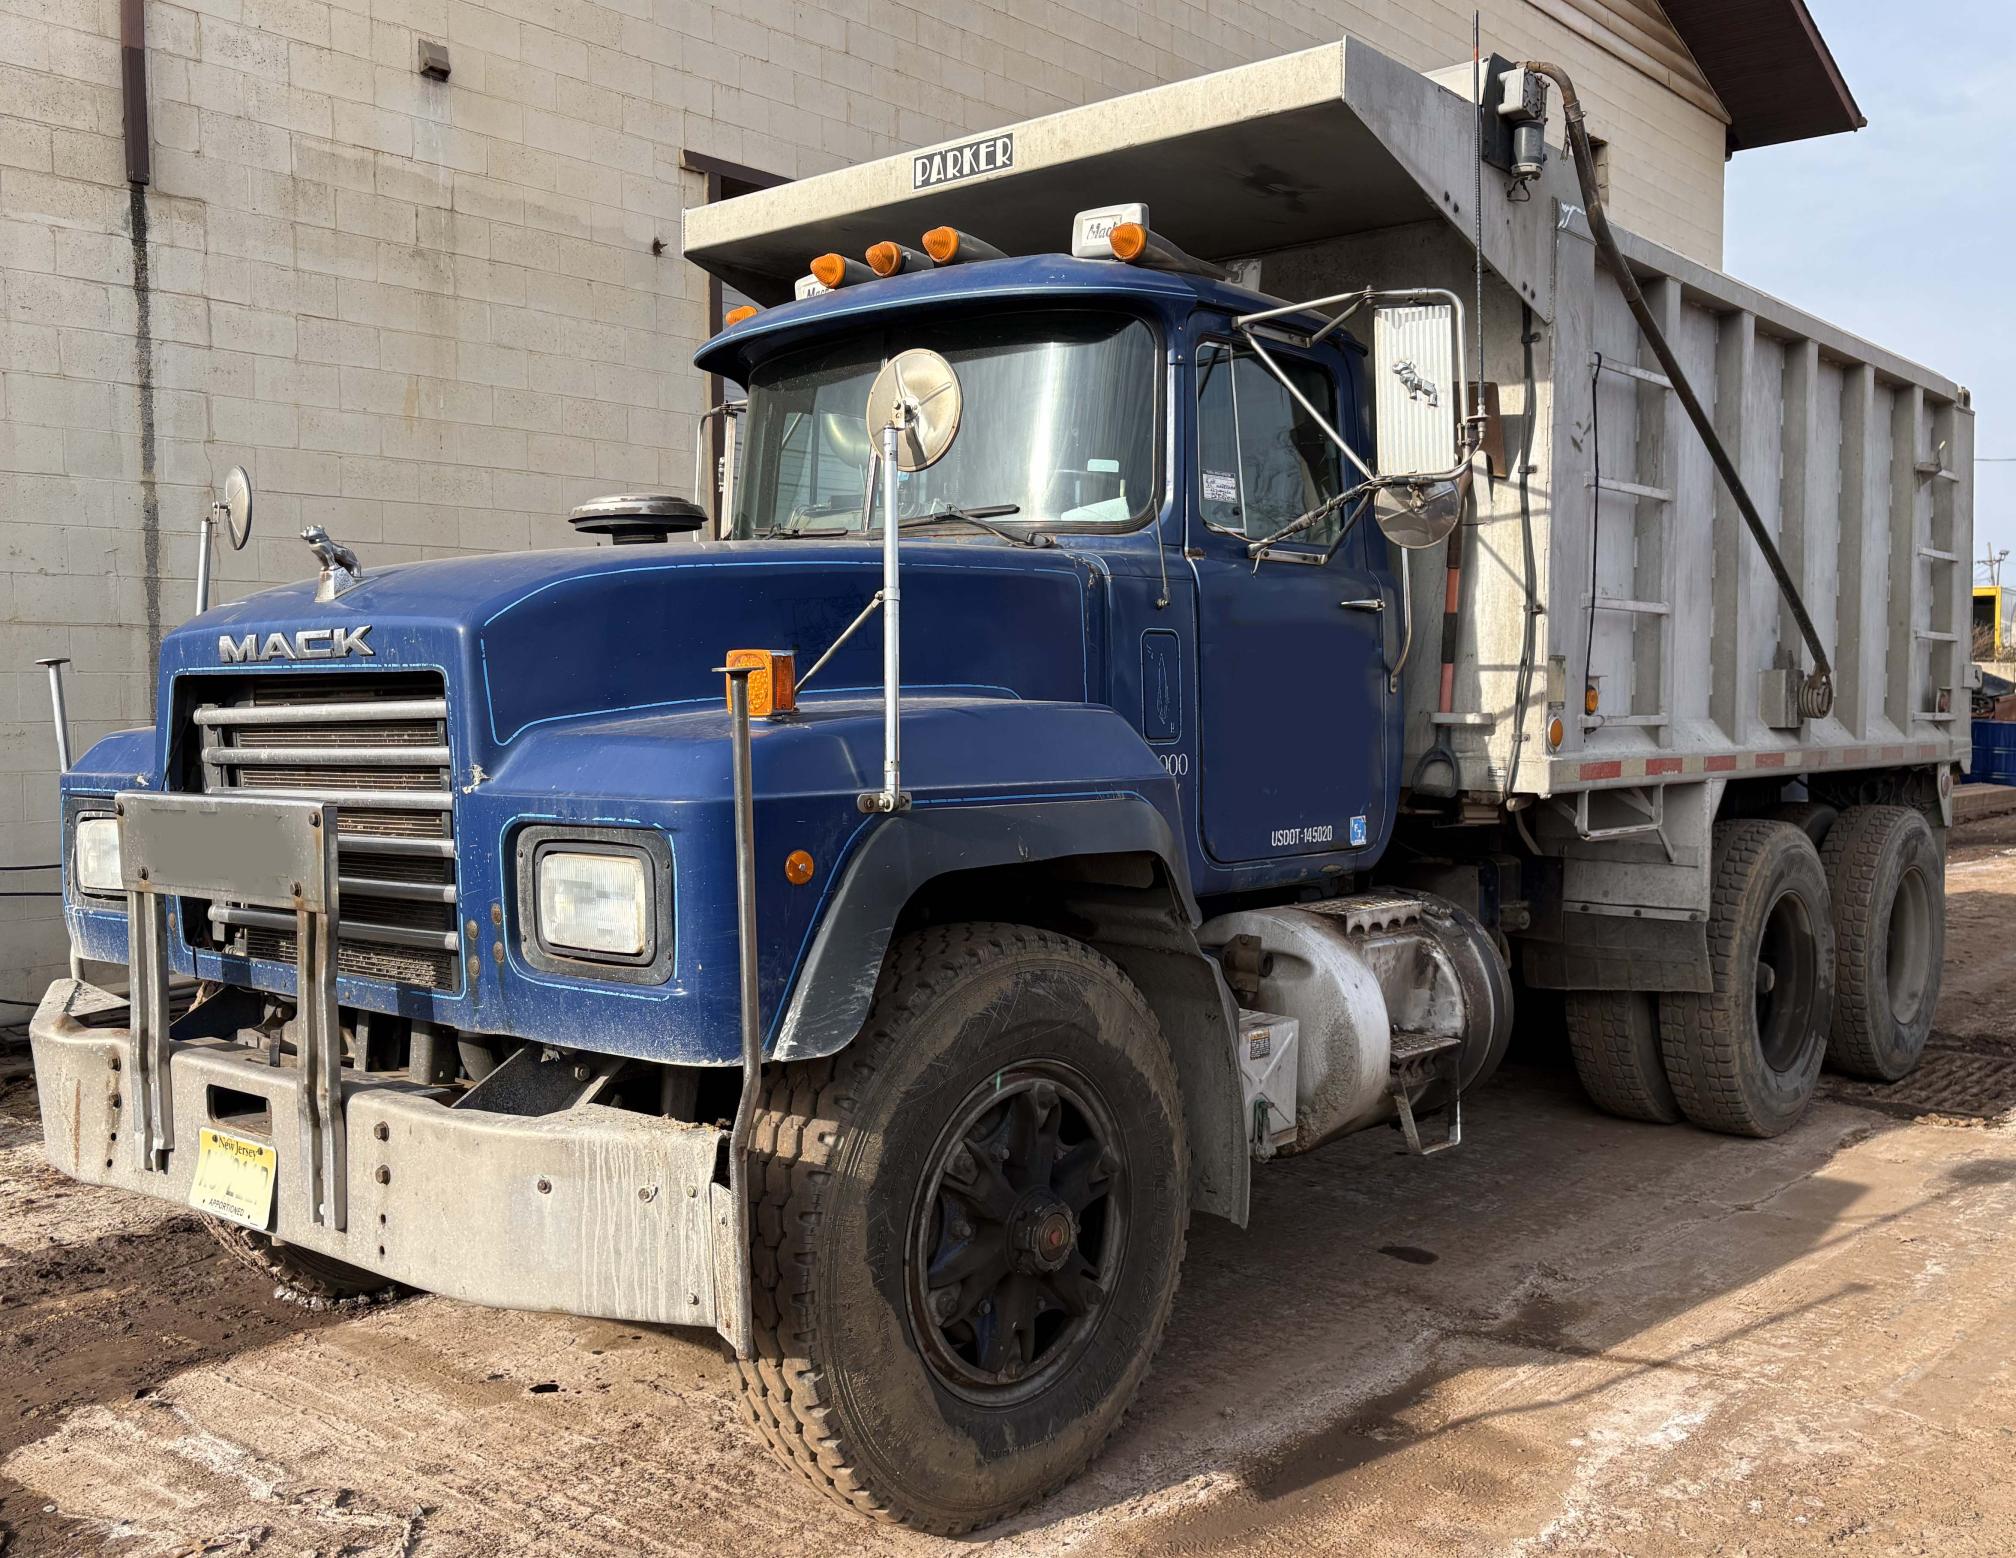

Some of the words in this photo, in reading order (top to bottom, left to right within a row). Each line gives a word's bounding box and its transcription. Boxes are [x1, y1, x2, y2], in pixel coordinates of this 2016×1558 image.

[915, 137, 1012, 187] PARKER
[219, 624, 376, 663] MACK
[1271, 825, 1333, 847] USDOT-145020
[218, 1135, 235, 1152] New
[235, 1141, 258, 1160] Jersey
[208, 1198, 246, 1217] APPORTIONED
